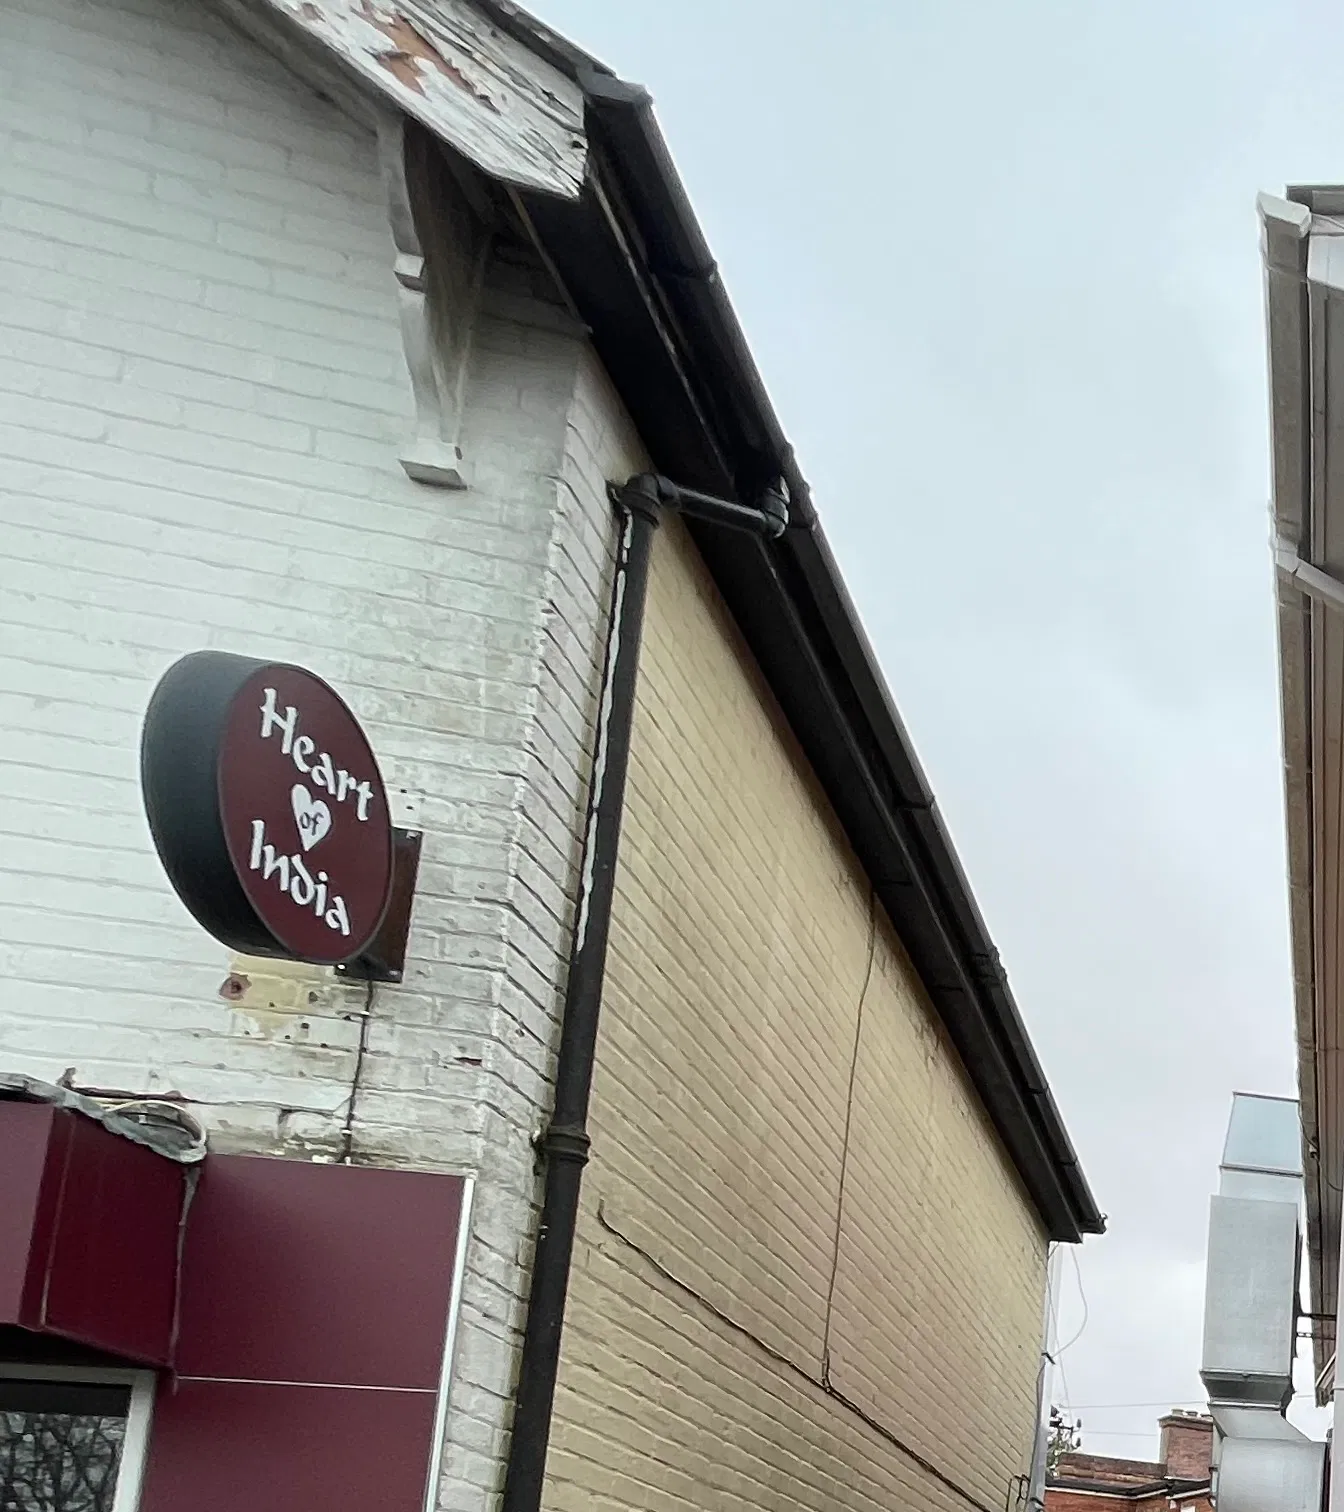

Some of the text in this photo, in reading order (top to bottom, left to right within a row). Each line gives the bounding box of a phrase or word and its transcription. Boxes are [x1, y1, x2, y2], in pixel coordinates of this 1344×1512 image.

[259, 687, 375, 821] Heart
[248, 819, 351, 937] India
[299, 811, 324, 835] of
